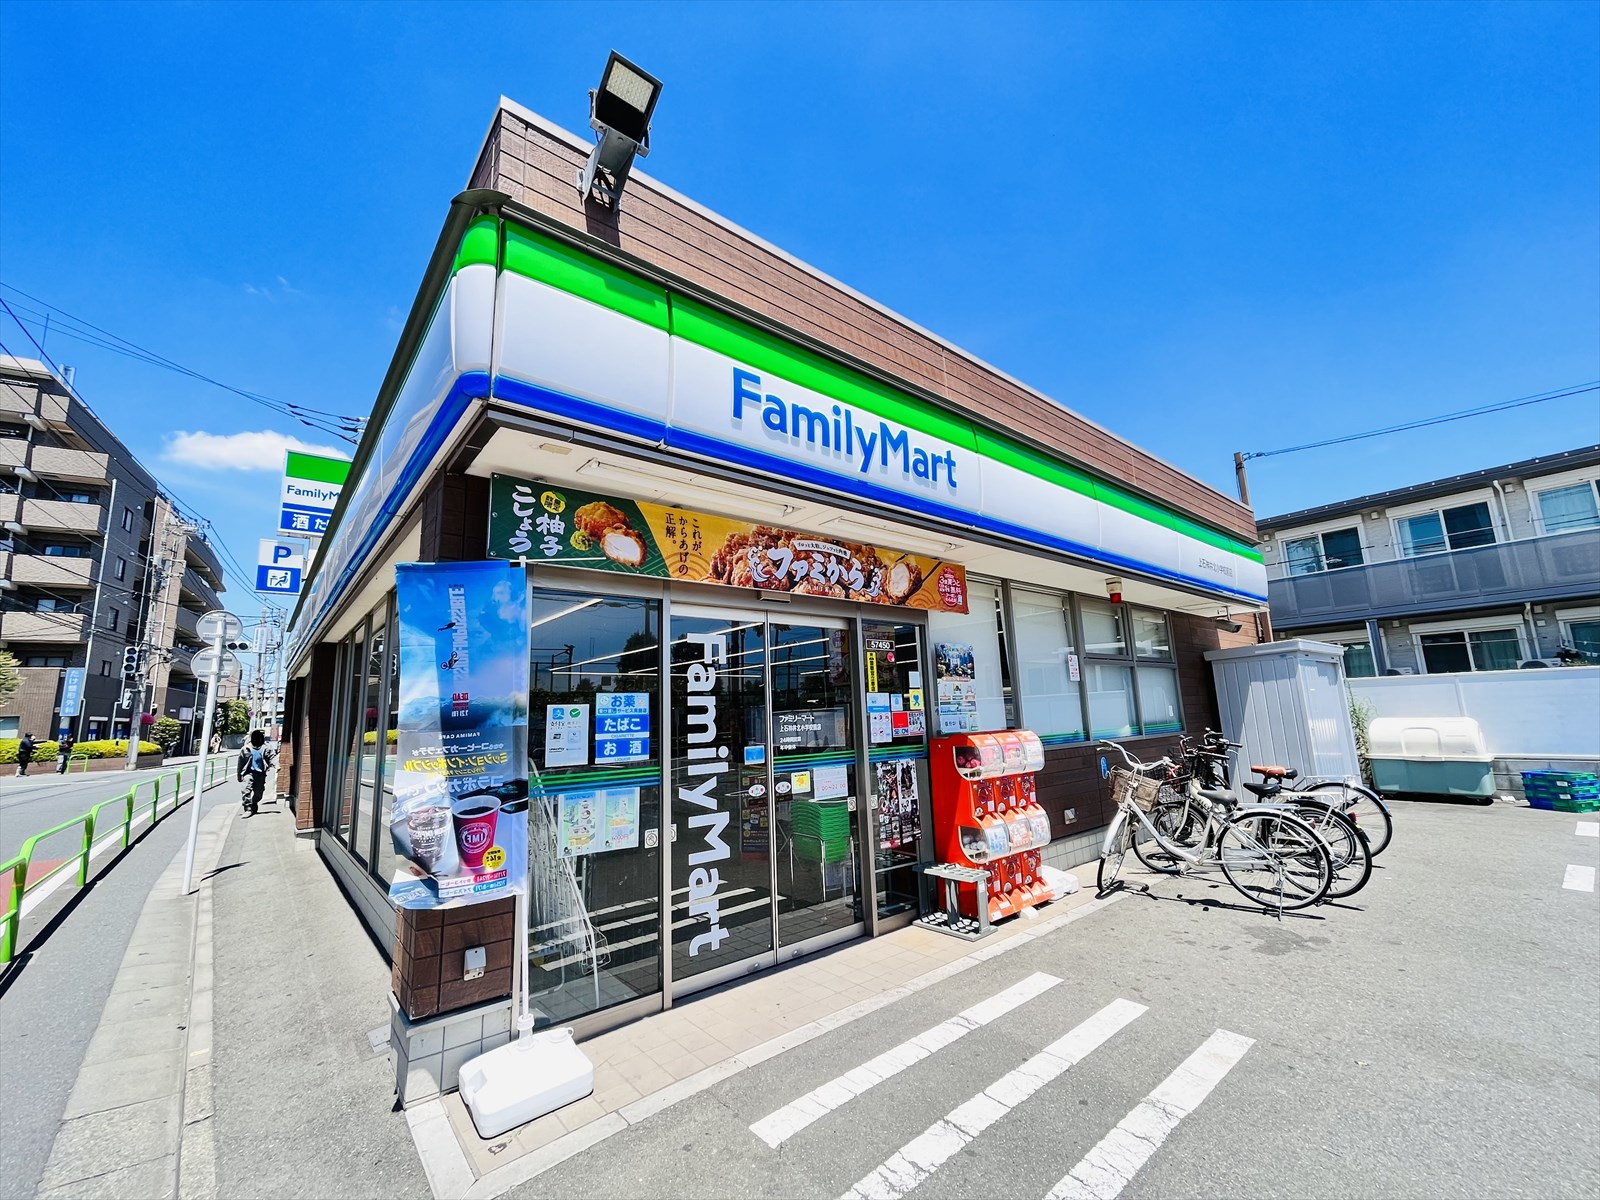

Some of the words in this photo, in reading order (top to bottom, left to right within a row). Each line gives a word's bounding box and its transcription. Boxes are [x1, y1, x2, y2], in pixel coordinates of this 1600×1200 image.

[732, 366, 957, 489] FamilyMart
[292, 513, 310, 529] 酒
[508, 484, 536, 553] こしょう
[536, 513, 566, 556] 柚子
[665, 512, 677, 545] 正解。
[678, 515, 689, 575] からあげの
[692, 518, 702, 556] これが、
[273, 545, 292, 564] P
[871, 640, 890, 649] 57450
[611, 694, 635, 708] お薬
[604, 718, 641, 732] たばこ
[779, 714, 815, 723] ファミリーマート
[678, 632, 731, 957] FamilyMart
